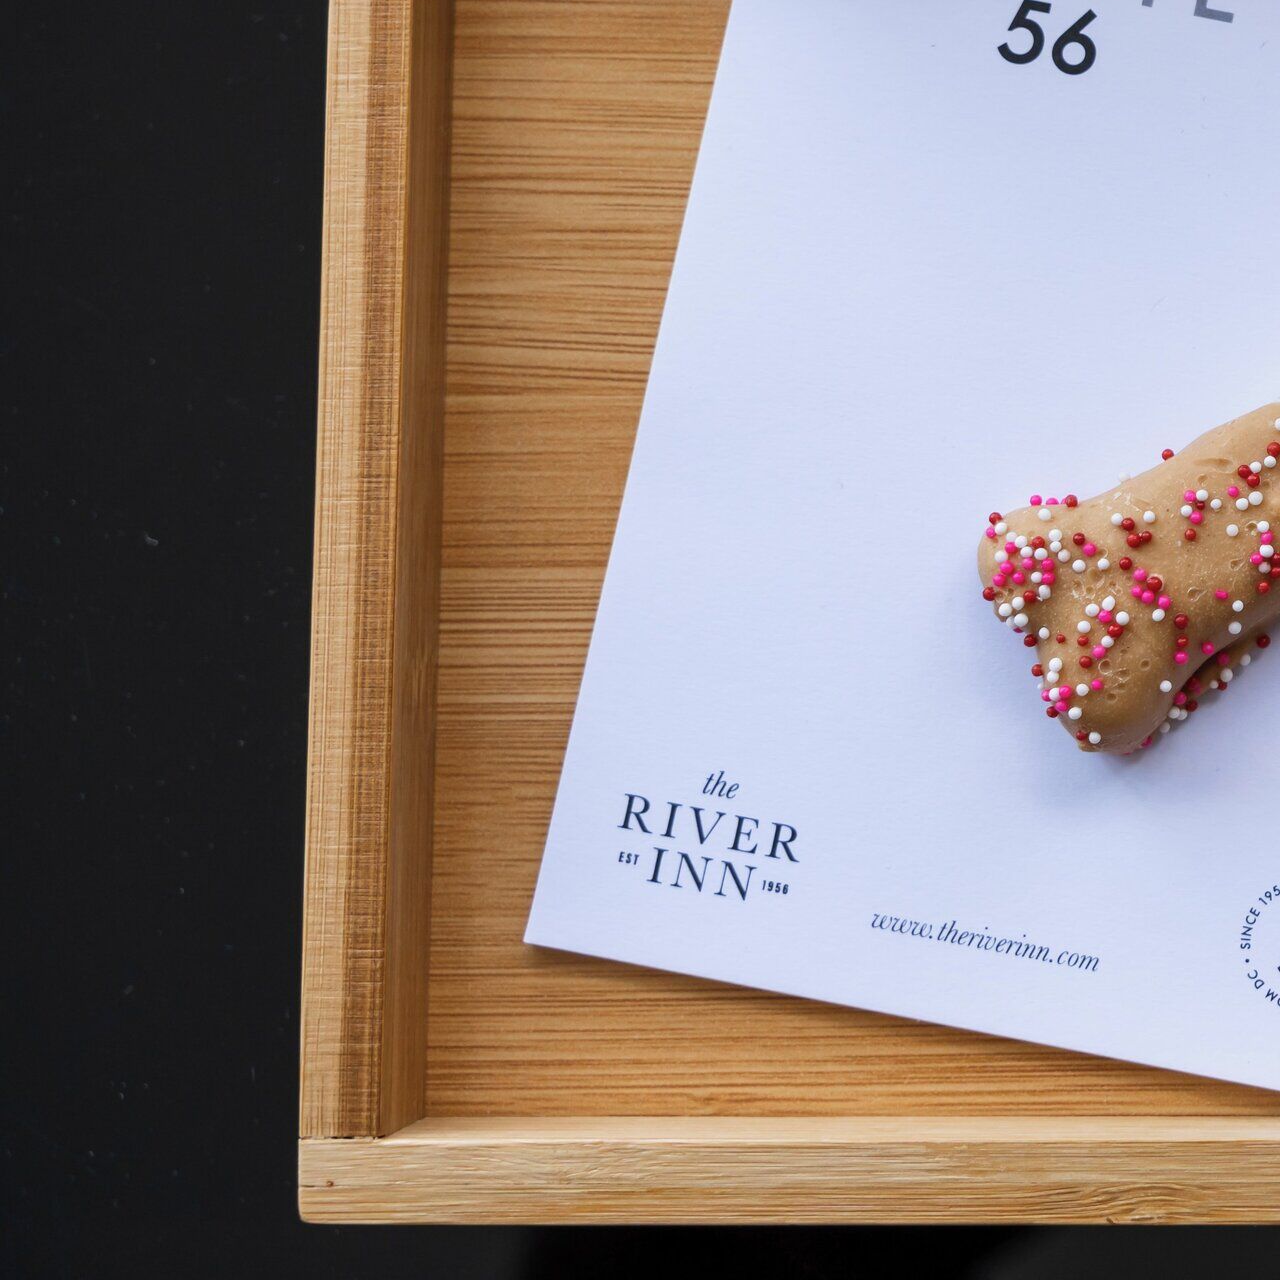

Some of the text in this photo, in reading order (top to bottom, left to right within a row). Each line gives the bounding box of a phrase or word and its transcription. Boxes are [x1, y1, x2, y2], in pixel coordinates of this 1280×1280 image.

[702, 770, 740, 799] the
[617, 793, 800, 863] RIVER
[618, 846, 789, 901] EST INN 1956
[871, 911, 1100, 972] www.theriverinn.com
[1240, 907, 1261, 950] SINCE
[1247, 969, 1265, 990] DC
